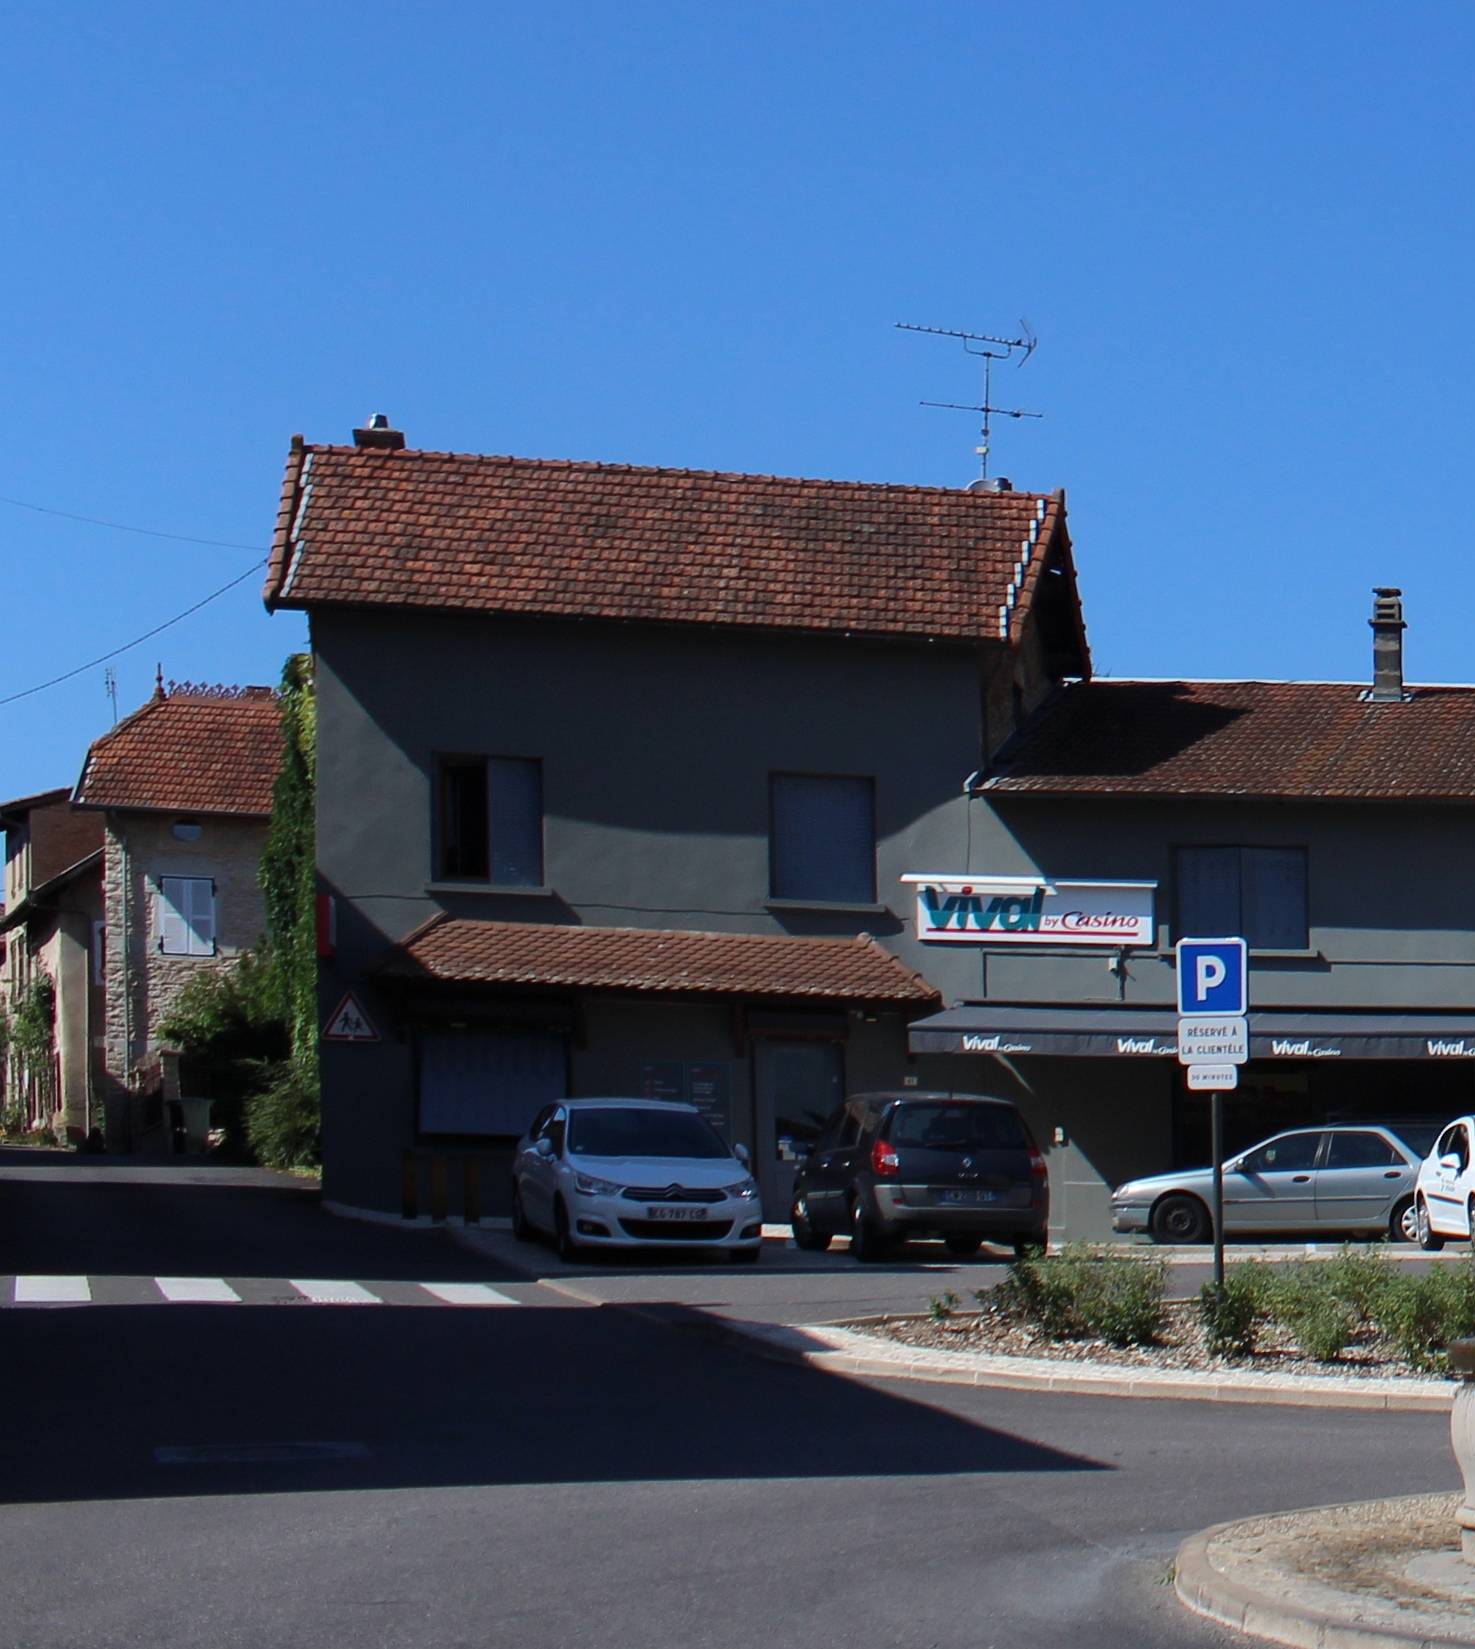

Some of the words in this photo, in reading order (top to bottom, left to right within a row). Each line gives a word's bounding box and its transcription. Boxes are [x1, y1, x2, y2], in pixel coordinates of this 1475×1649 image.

[925, 885, 1046, 932] Vival
[1045, 915, 1058, 930] by
[1061, 911, 1138, 930] Casino
[1196, 955, 1226, 1001] P
[1187, 1026, 1227, 1037] RÉSERVÉ
[962, 1035, 999, 1051] Vival
[1117, 1038, 1155, 1054] Vival
[1182, 1045, 1193, 1055] LA
[1272, 1040, 1311, 1056] Vival
[1427, 1040, 1465, 1056] Vival
